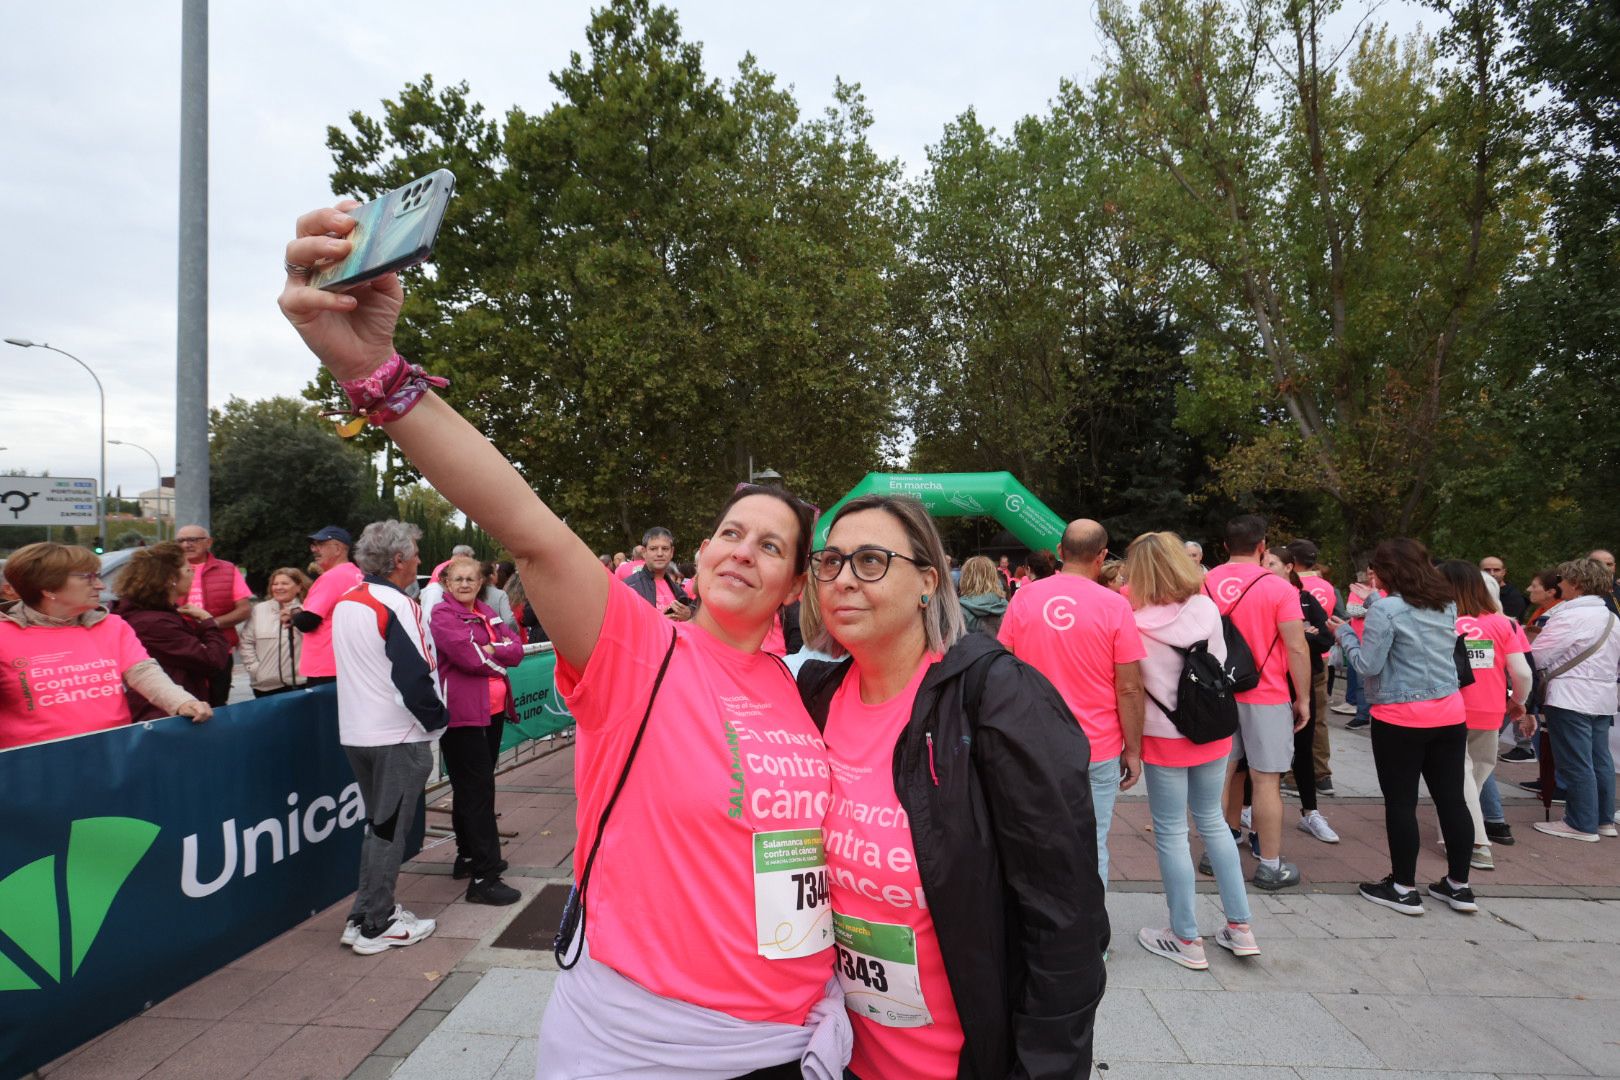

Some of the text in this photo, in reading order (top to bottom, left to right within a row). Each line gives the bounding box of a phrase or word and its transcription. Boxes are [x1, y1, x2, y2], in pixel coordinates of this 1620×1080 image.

[889, 480, 942, 489] En marcha
[31, 658, 118, 678] En marcha
[33, 669, 120, 692] contra el
[38, 683, 127, 707] cáncer
[513, 687, 549, 708] cáncer
[523, 705, 543, 720] uno
[746, 752, 831, 779] contra
[181, 781, 369, 898] Unica
[763, 838, 803, 849] Salamanca
[763, 849, 790, 859] contra
[799, 847, 817, 855] cáncer
[791, 870, 830, 911] 7344
